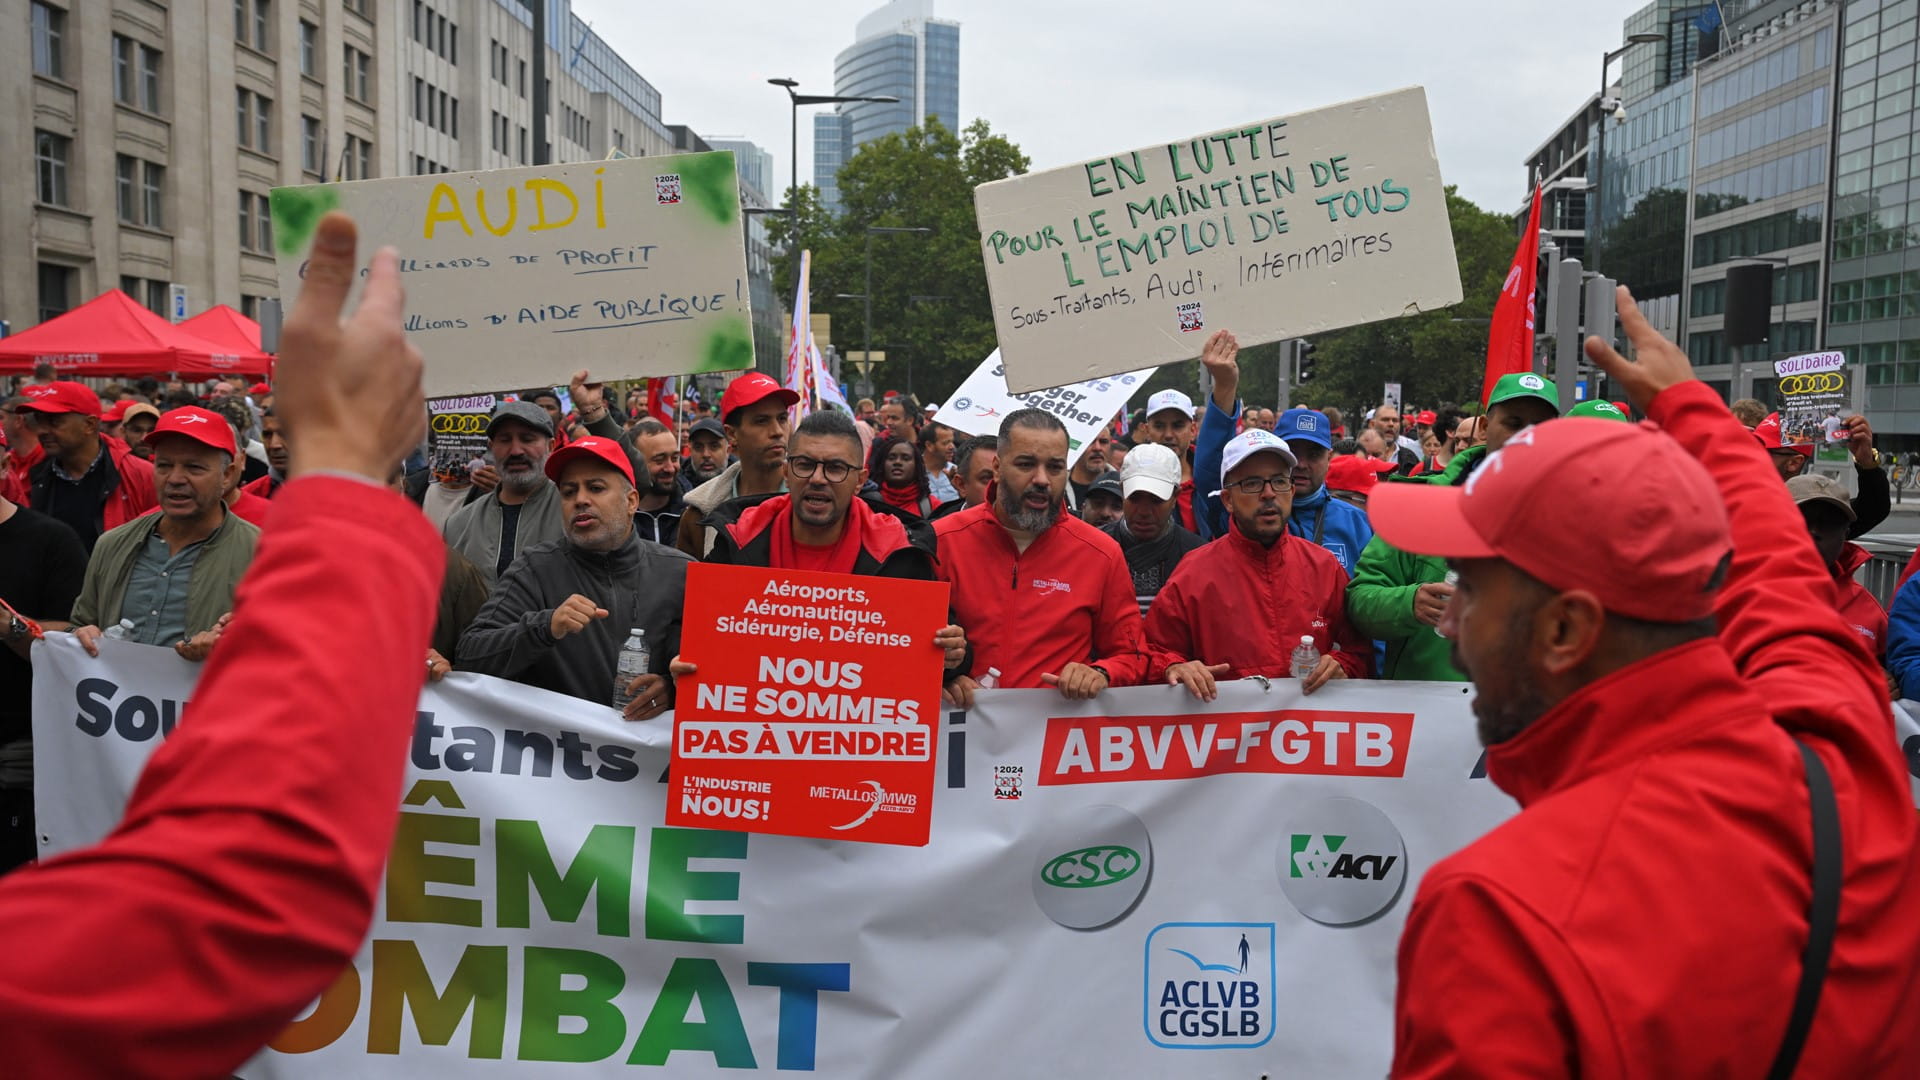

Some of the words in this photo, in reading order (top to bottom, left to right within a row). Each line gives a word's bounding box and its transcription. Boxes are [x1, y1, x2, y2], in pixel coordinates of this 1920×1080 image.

[1085, 151, 1146, 197] EN
[1167, 121, 1290, 182] LUTTE
[987, 225, 1063, 264] POUR
[1074, 209, 1112, 243] LE
[1310, 154, 1350, 188] DE
[1249, 208, 1290, 243] DE
[1315, 178, 1411, 222] TOUS
[509, 255, 541, 265] DE
[1238, 232, 1393, 288] Intérimaires
[1181, 302, 1201, 311] 2024
[763, 580, 870, 605] Aéroports,
[743, 599, 887, 626] Aéronautique,
[716, 616, 824, 643] Sidérurgie,
[829, 626, 911, 647] Défense
[758, 656, 863, 690] NOUS
[696, 683, 747, 712] NE
[754, 688, 919, 725] SOMMES
[683, 729, 749, 754] PAS
[754, 724, 780, 755] À
[787, 731, 926, 756] VENDRE
[1055, 720, 1394, 775] ABVV-FGTB
[683, 775, 771, 793] L'INDUSTRIE
[810, 785, 879, 803] METALLOS
[882, 792, 917, 806] MWB
[386, 779, 748, 944] ÊME
[1051, 848, 1131, 883] CSC
[1327, 853, 1398, 880] ACV
[266, 938, 850, 1071] OMBAT
[1160, 980, 1260, 1008] ACLVB
[1160, 1009, 1260, 1037] CGSLB
